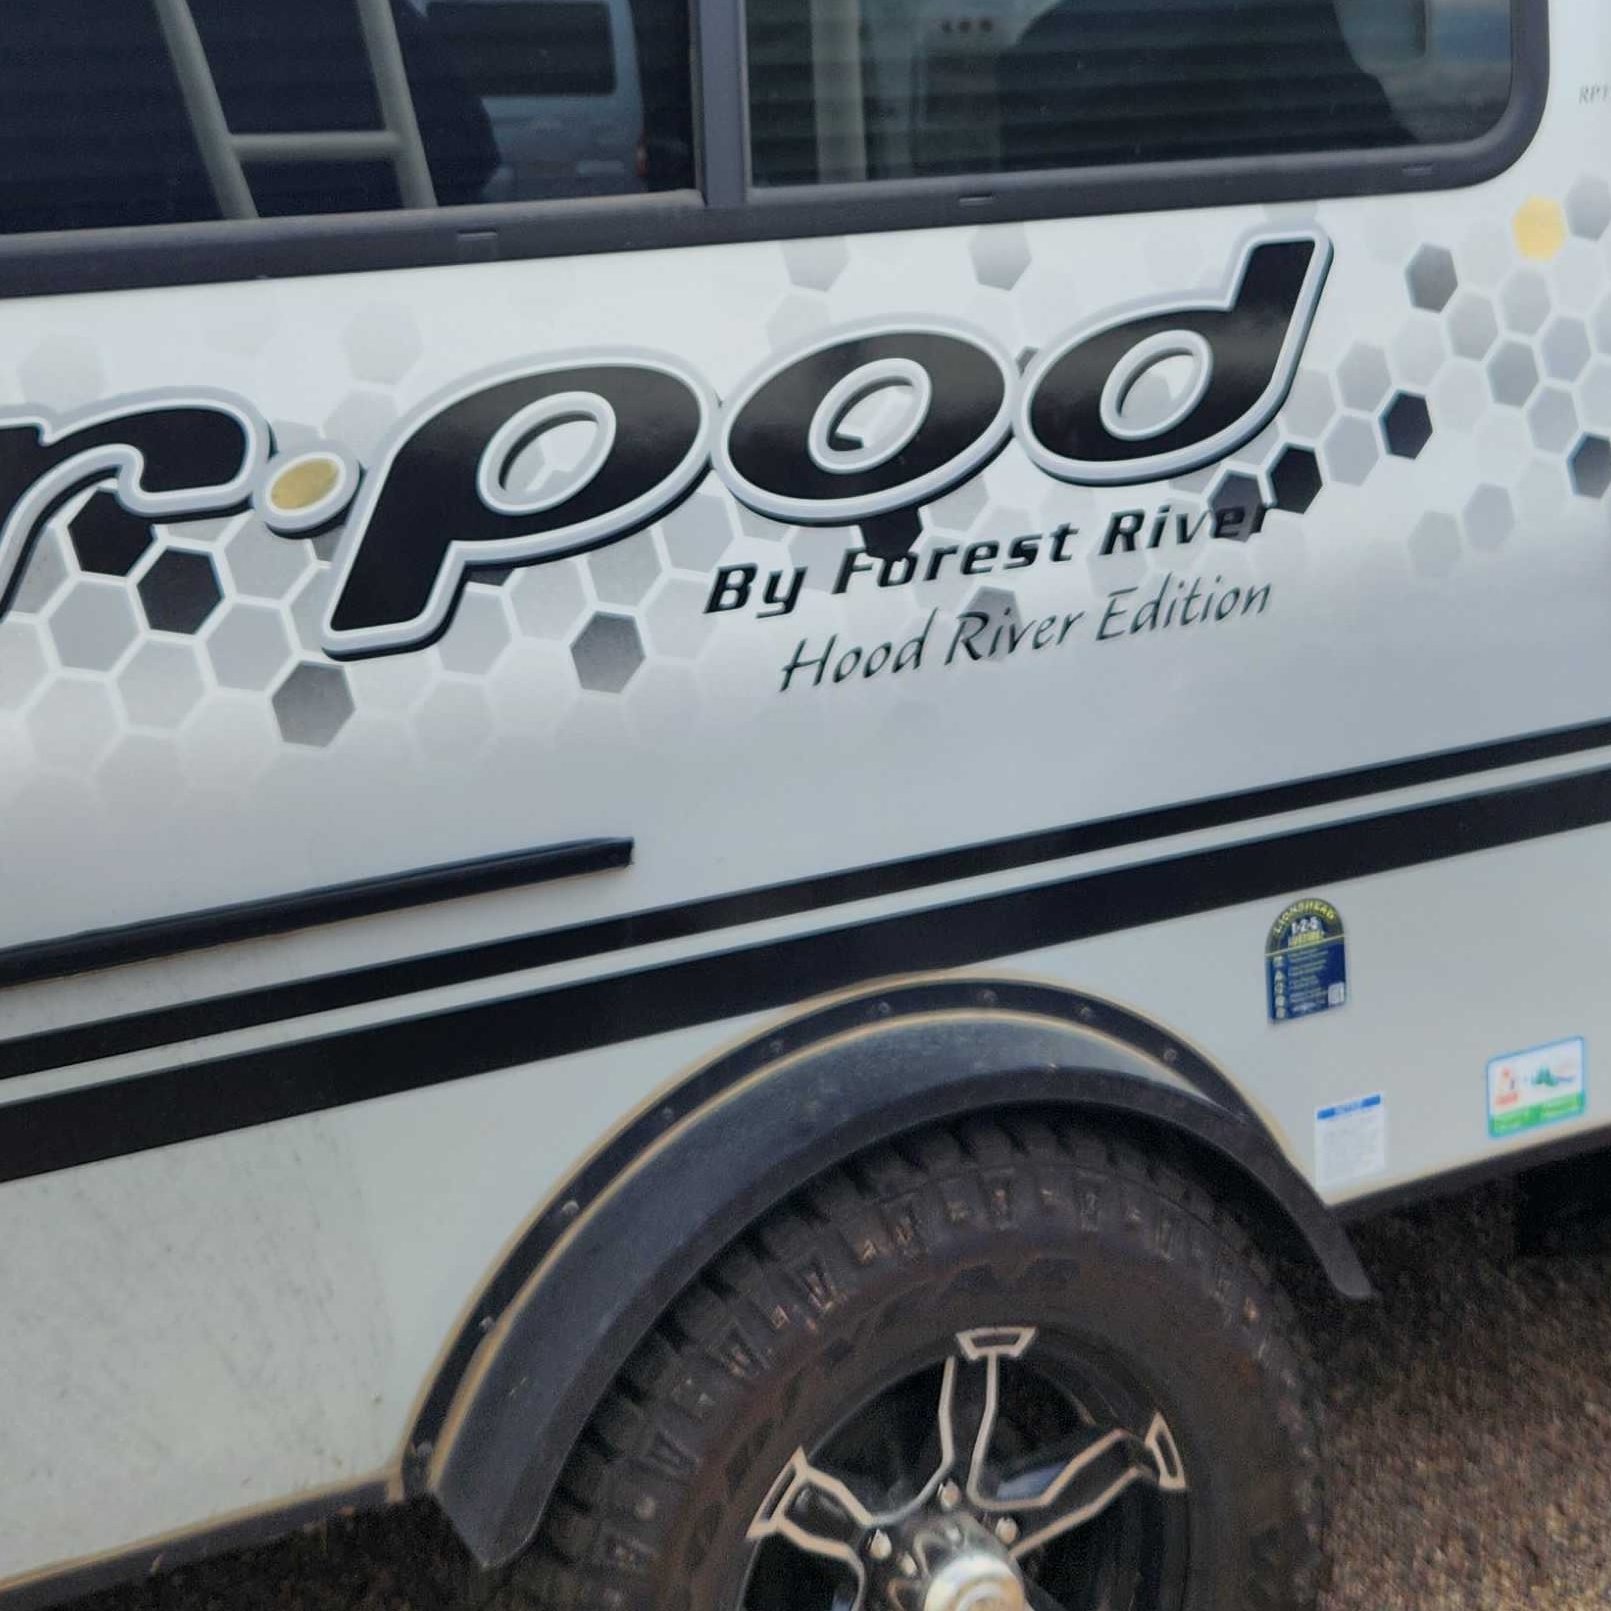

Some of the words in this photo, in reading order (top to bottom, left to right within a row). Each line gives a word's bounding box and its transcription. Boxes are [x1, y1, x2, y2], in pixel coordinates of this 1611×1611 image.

[705, 562, 809, 619] By
[831, 522, 1079, 595] Forest
[1098, 503, 1268, 557] River
[779, 608, 938, 692] Hood
[945, 607, 1084, 665] River
[1095, 571, 1272, 641] Edition
